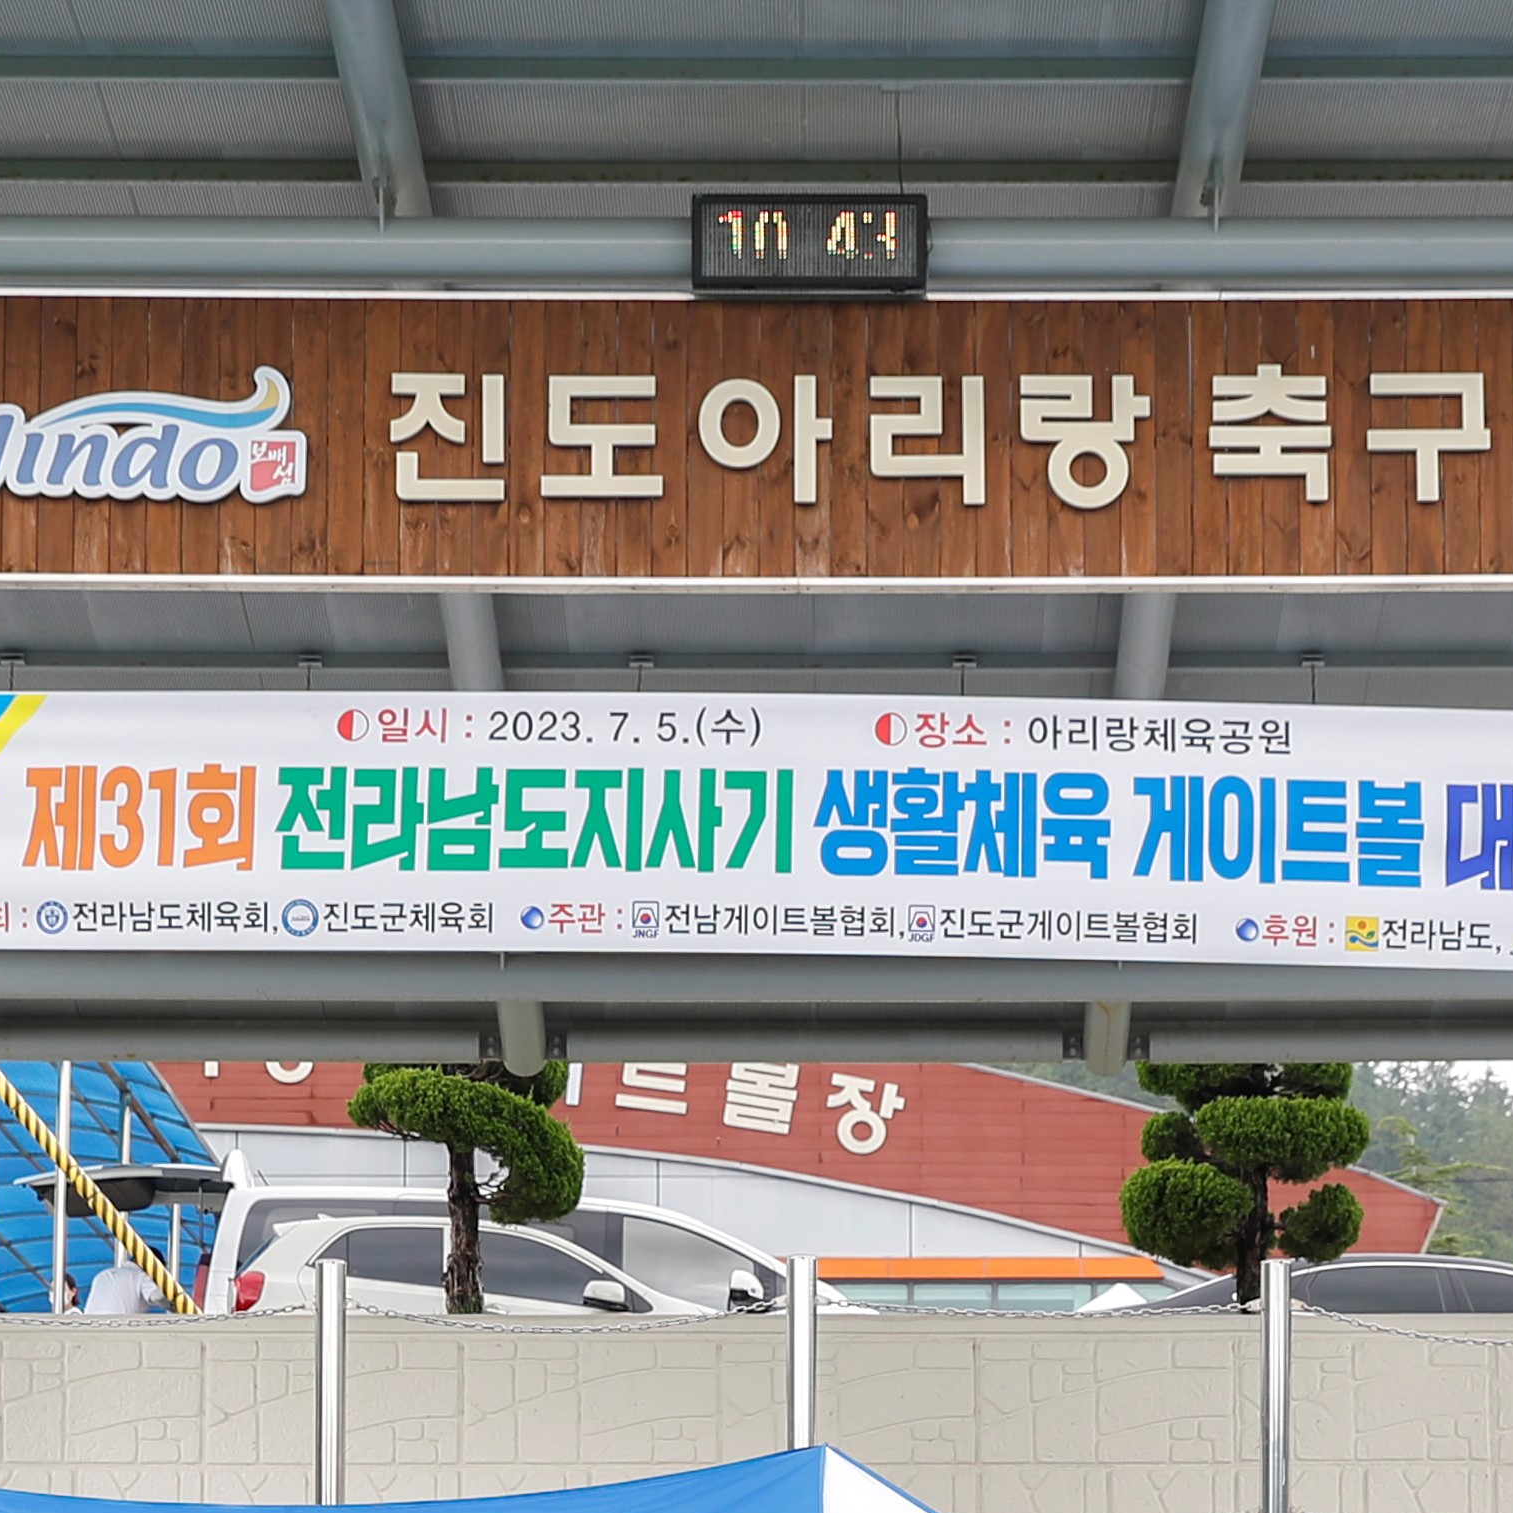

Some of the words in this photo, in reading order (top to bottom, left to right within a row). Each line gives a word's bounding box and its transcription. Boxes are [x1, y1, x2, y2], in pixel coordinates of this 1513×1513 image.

[390, 372, 1151, 510] 진도아리랑
[378, 707, 447, 744] 일시
[488, 710, 593, 743] 2023.
[609, 711, 640, 744] 7.
[914, 712, 987, 749] 장소
[1028, 714, 1292, 756] 아리랑체육공원
[21, 763, 257, 872] 제31회
[275, 766, 794, 874] 전라남도지사기
[813, 767, 1111, 880] 생활체육
[1132, 775, 1425, 888] 게이트볼
[323, 901, 493, 934] 진도군체육회
[548, 903, 606, 934] 주관
[939, 907, 1197, 945] 진도군게이트볼협회
[632, 929, 659, 939] JNGF
[1261, 914, 1317, 947] 후원
[908, 933, 935, 942] JDGF
